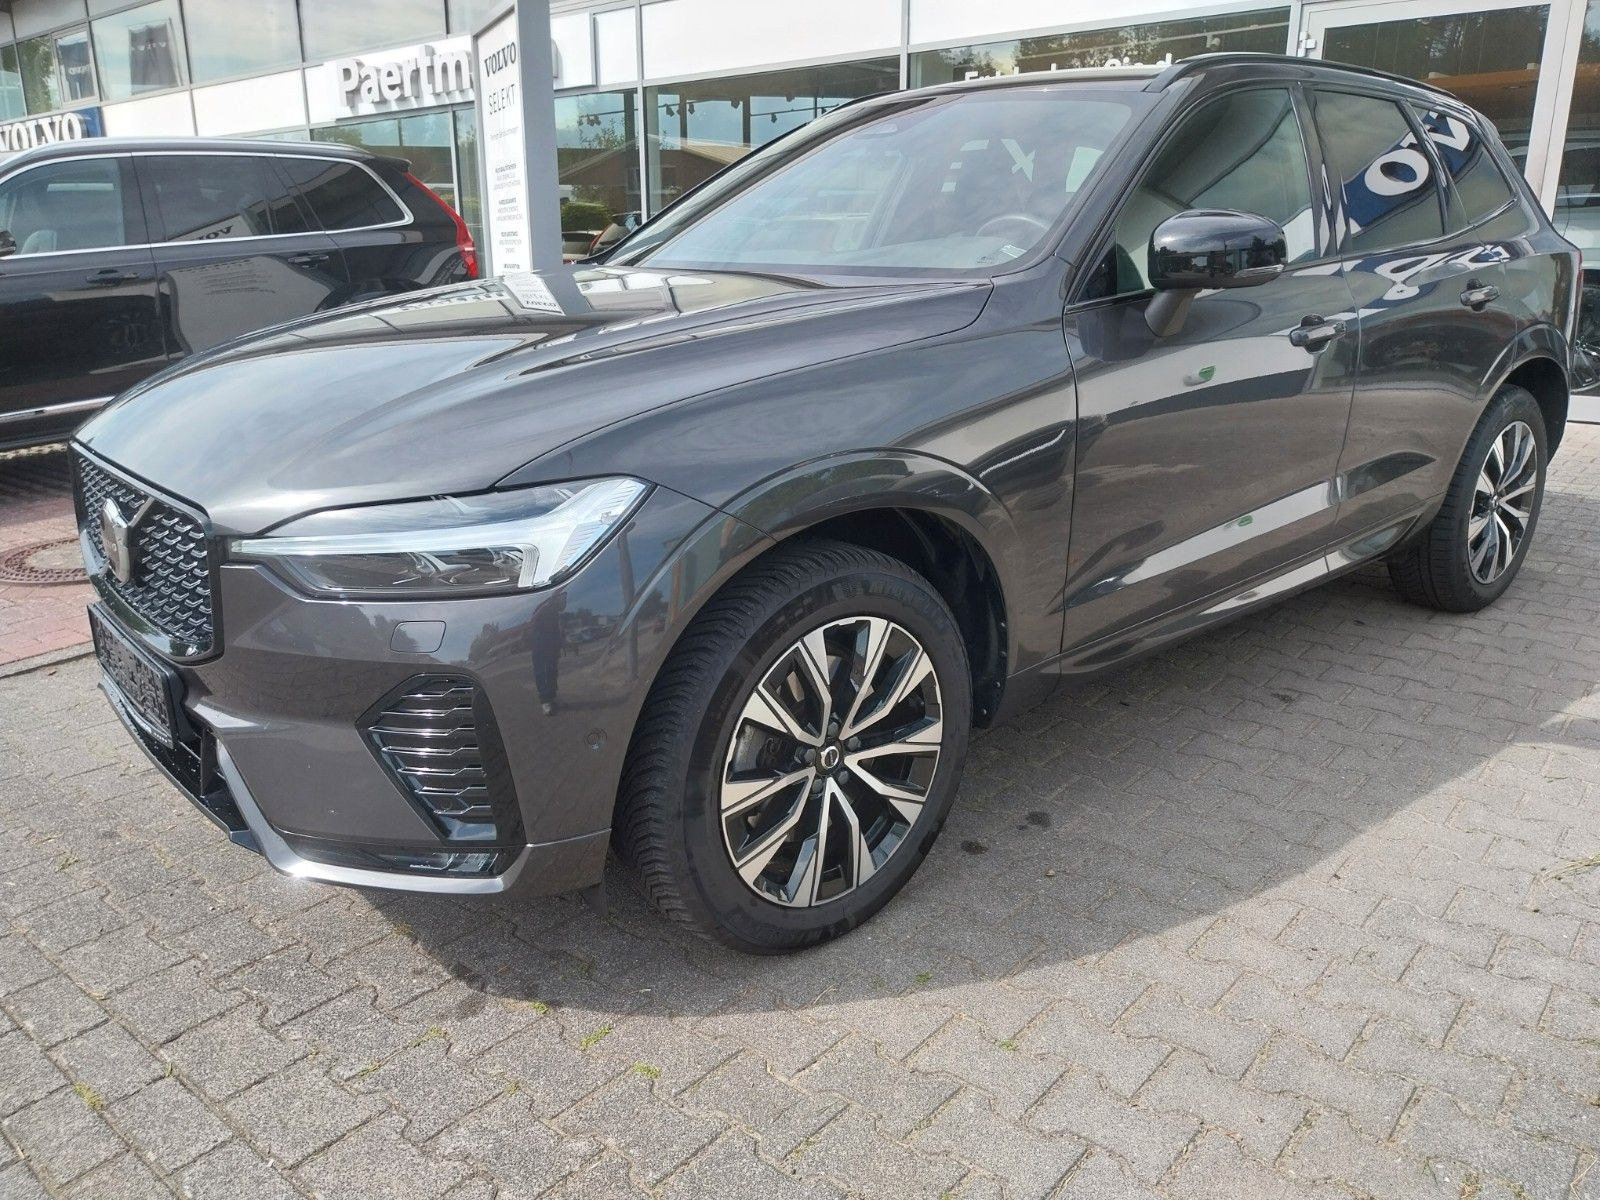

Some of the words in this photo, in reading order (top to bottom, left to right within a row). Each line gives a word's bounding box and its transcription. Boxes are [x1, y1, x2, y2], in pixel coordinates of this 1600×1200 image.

[335, 45, 475, 109] Paertm
[484, 42, 517, 77] VOLVO
[488, 84, 515, 115] SELEKT
[0, 112, 82, 152] VOLVO
